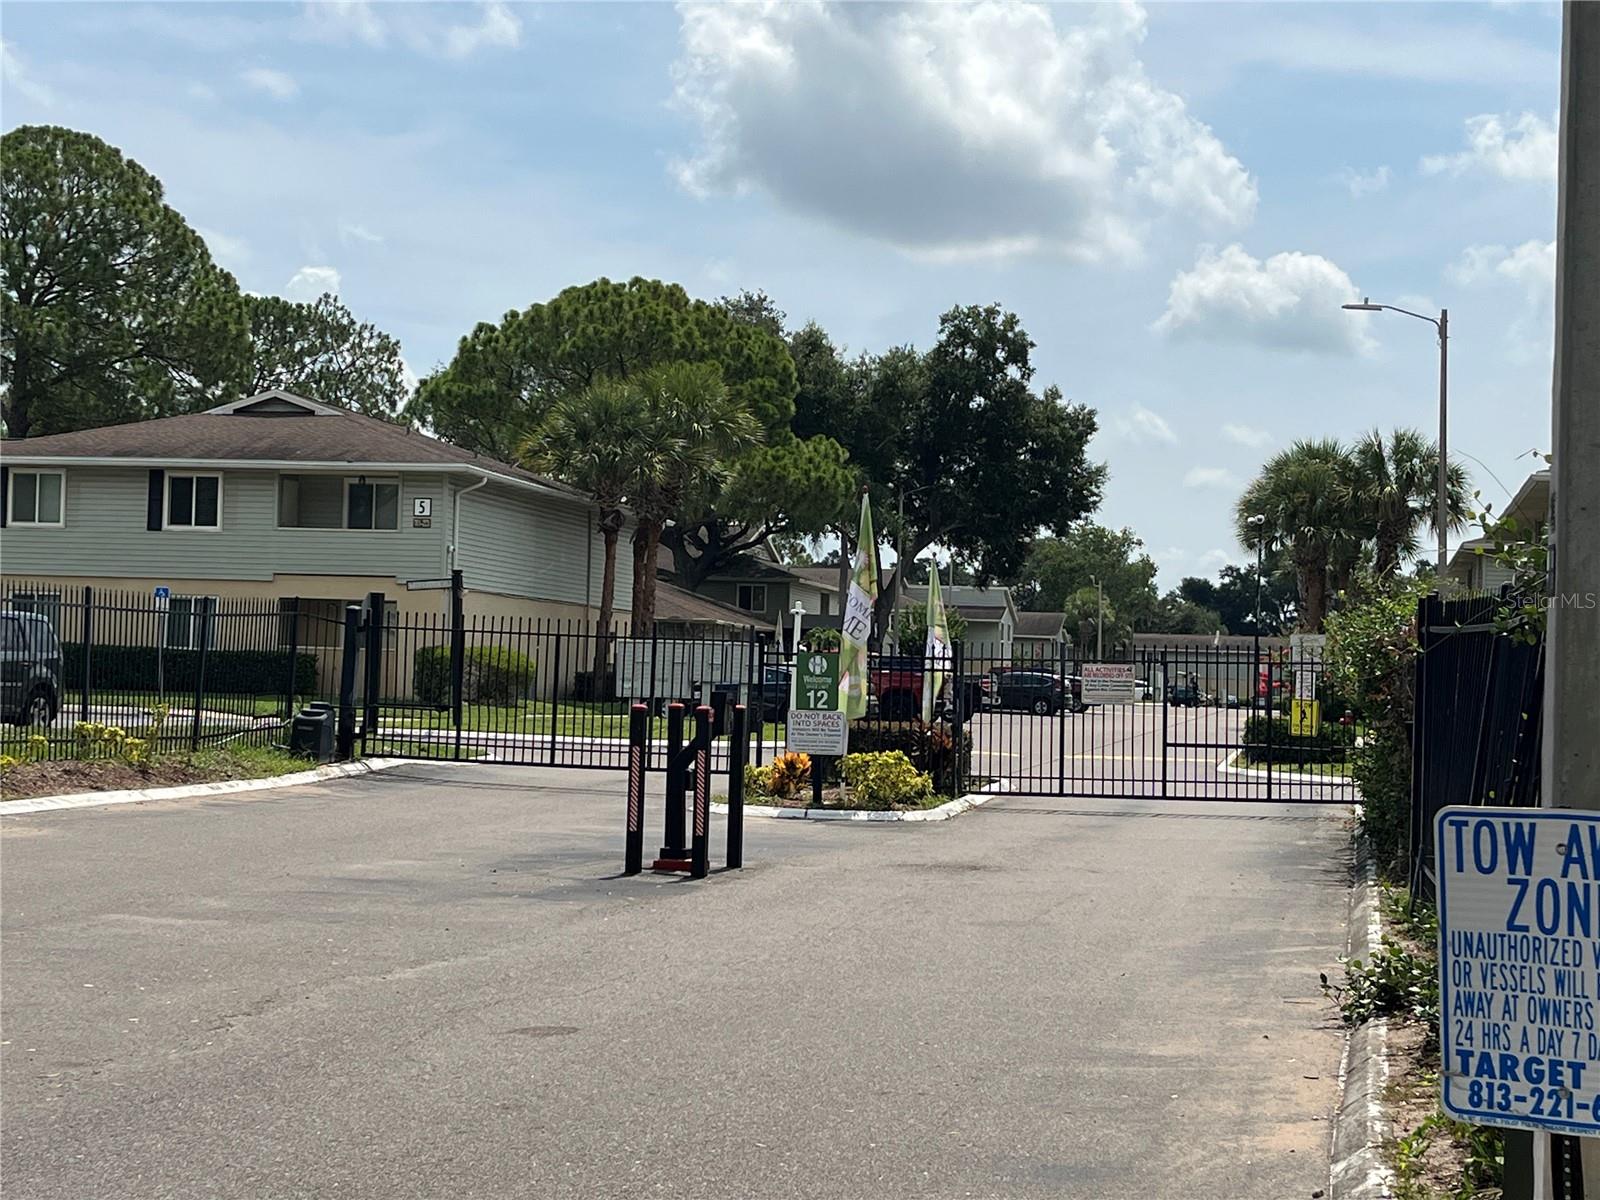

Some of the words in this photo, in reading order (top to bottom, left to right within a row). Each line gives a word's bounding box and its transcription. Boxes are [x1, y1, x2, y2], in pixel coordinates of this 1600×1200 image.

[418, 501, 426, 514] 5
[790, 712, 803, 720] DO
[822, 713, 842, 721] BACK
[806, 690, 829, 709] 12
[813, 720, 840, 728] SPACES
[1448, 819, 1537, 877] TOW
[1506, 878, 1600, 938] ZON
[1452, 930, 1583, 968] UNAUTHORIZED
[1453, 959, 1472, 988] OR
[1480, 962, 1546, 995] VESSELS
[1554, 968, 1589, 999] WILL
[1453, 989, 1494, 1019] AWAY
[1502, 994, 1519, 1022] AT
[1527, 996, 1594, 1031] OWNERS
[1455, 1019, 1474, 1047] 24
[1482, 1021, 1511, 1052] HRS
[1520, 1025, 1530, 1054] A
[1537, 1028, 1565, 1057] DAY
[1572, 1031, 1581, 1059] 7
[1455, 1048, 1586, 1090] TARGET
